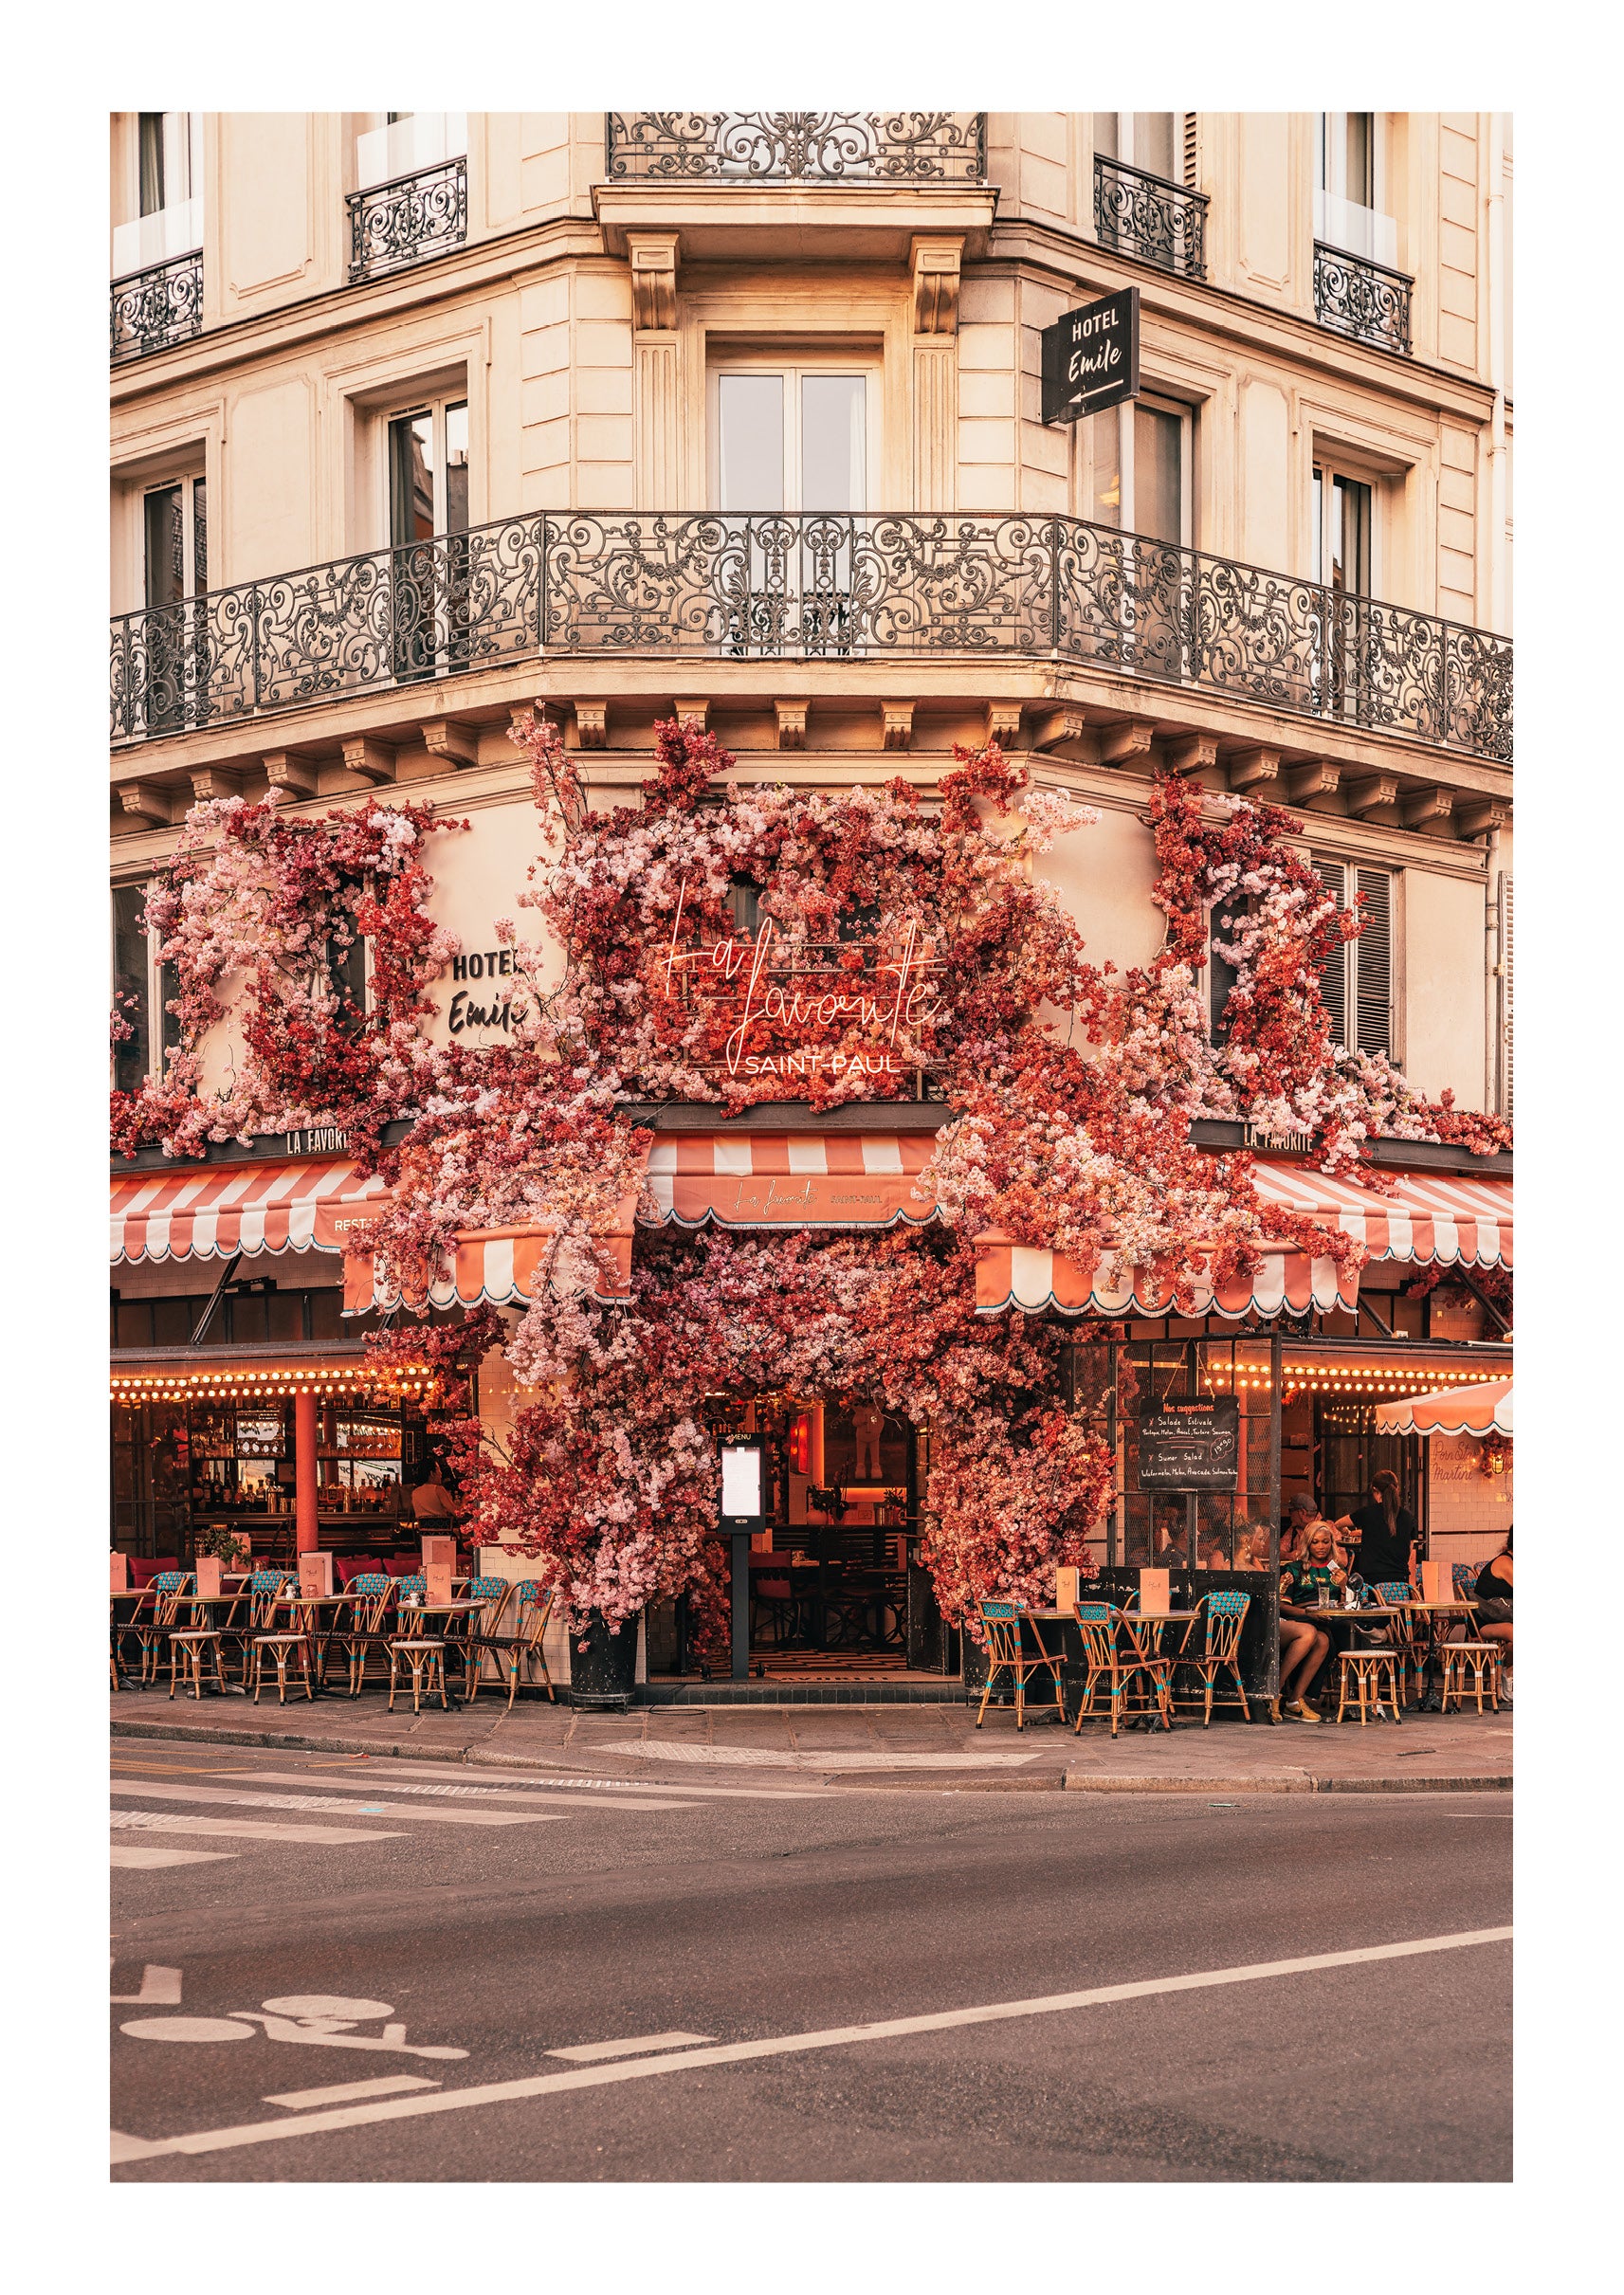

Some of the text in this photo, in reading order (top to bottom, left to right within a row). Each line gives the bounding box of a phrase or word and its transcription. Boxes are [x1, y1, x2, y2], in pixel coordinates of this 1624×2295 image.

[1072, 308, 1120, 342] HOTEL
[1068, 339, 1122, 383] Emile
[744, 1055, 902, 1075] SAINT-PAUL
[286, 1128, 352, 1155] LA FAVORI
[1243, 1123, 1258, 1147] LA
[1163, 1403, 1214, 1414] Nos suggestions
[1158, 1416, 1213, 1426] Salade Estivale
[1183, 1452, 1203, 1462] Salad
[1432, 1463, 1473, 1481] Martini
